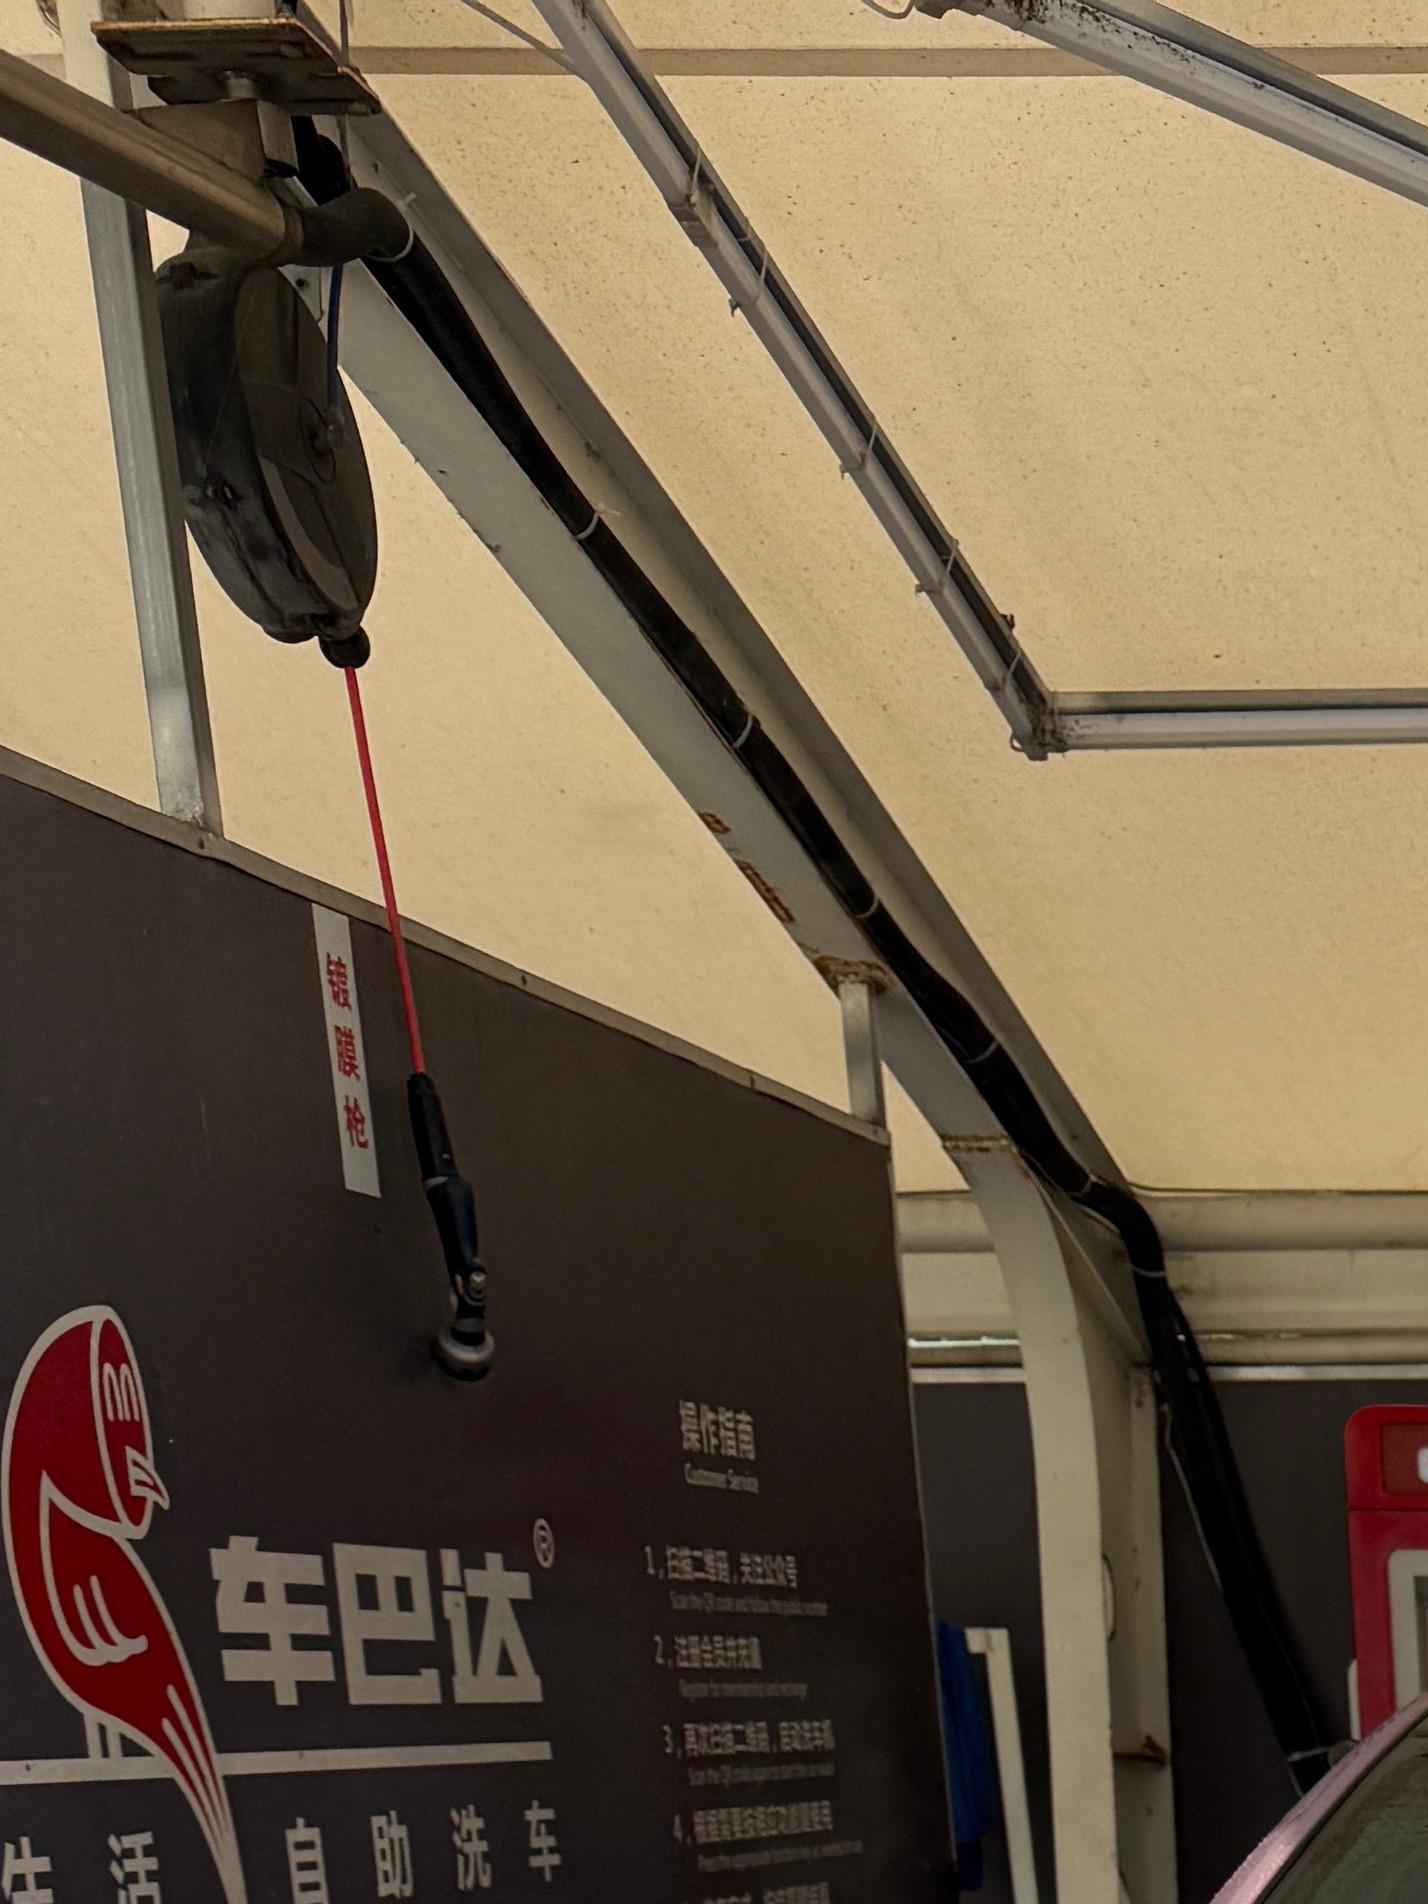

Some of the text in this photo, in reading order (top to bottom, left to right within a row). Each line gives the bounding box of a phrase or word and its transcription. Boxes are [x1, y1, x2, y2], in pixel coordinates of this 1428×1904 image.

[325, 951, 370, 1149] 镀膜枪
[209, 1534, 545, 1707] 车巴达
